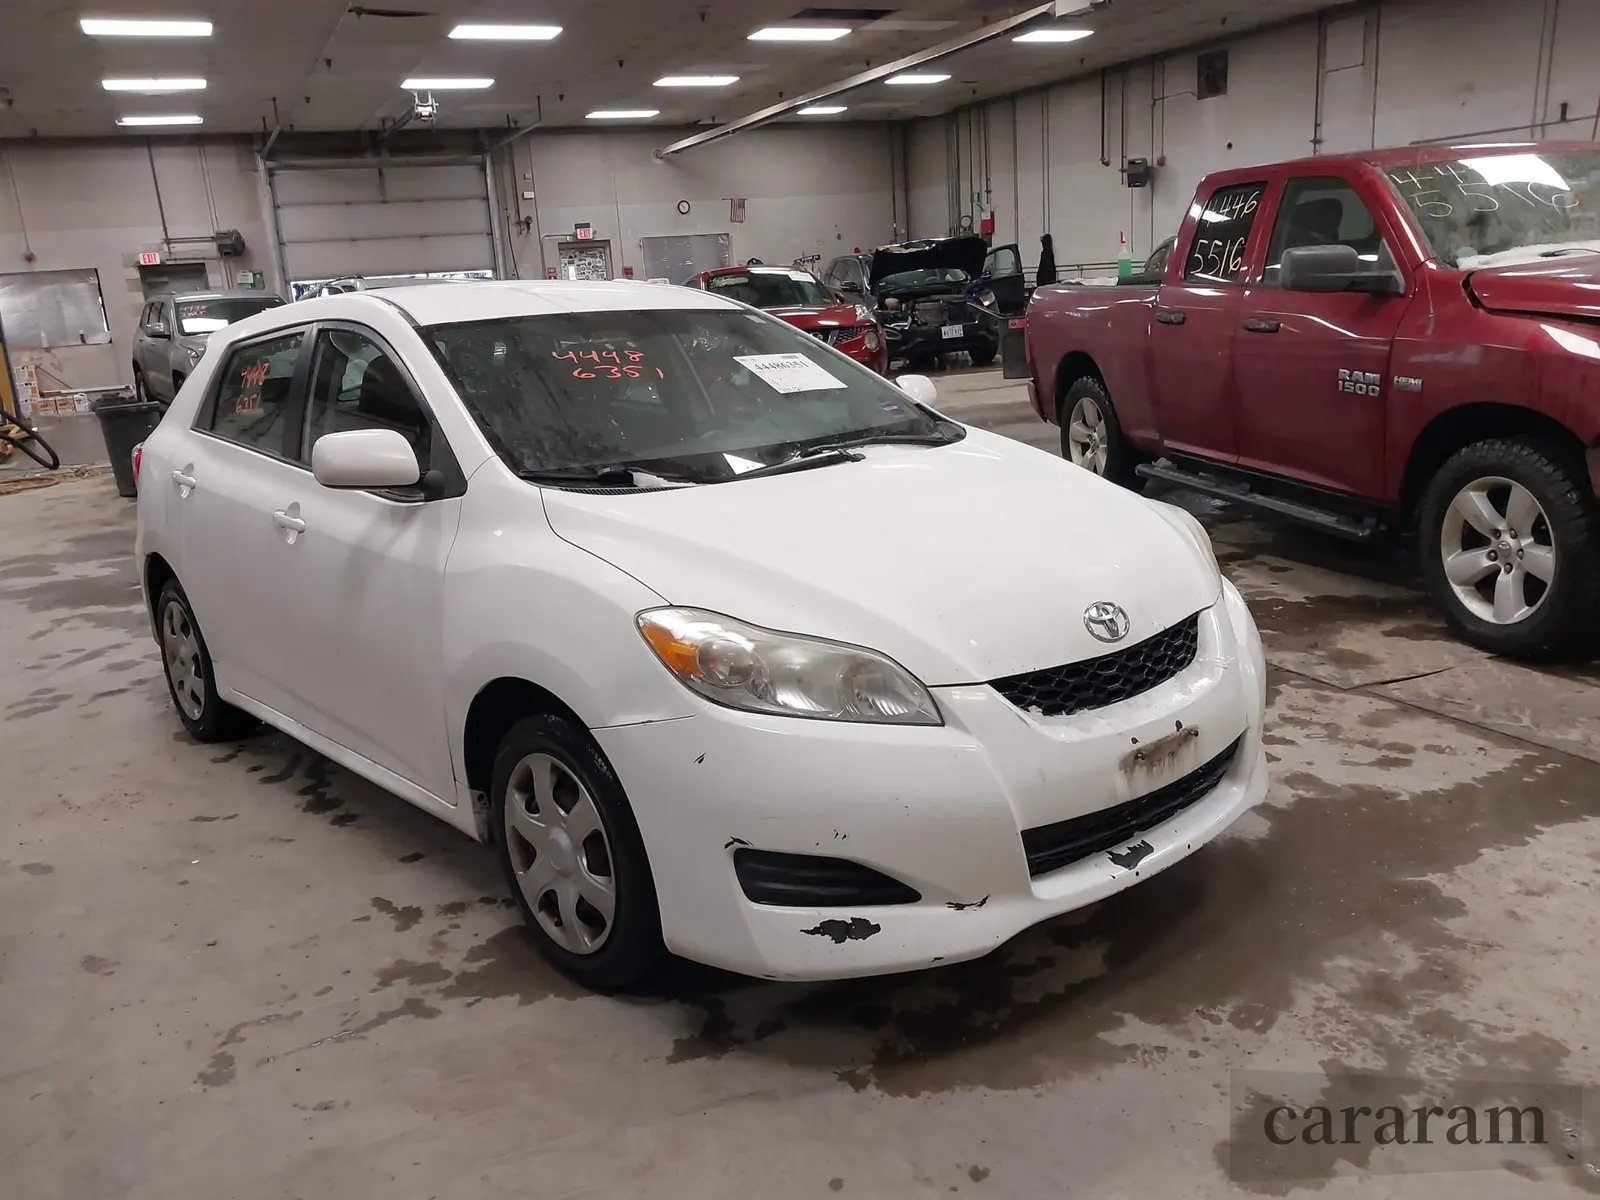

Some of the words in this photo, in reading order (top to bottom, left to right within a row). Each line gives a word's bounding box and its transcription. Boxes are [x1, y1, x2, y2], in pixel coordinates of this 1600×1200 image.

[579, 228, 592, 239] EXIT
[1190, 236, 1245, 277] 5516
[572, 365, 664, 379] 6351
[754, 360, 809, 371] 44486351
[1338, 368, 1380, 385] RAM
[1338, 380, 1380, 397] 1500
